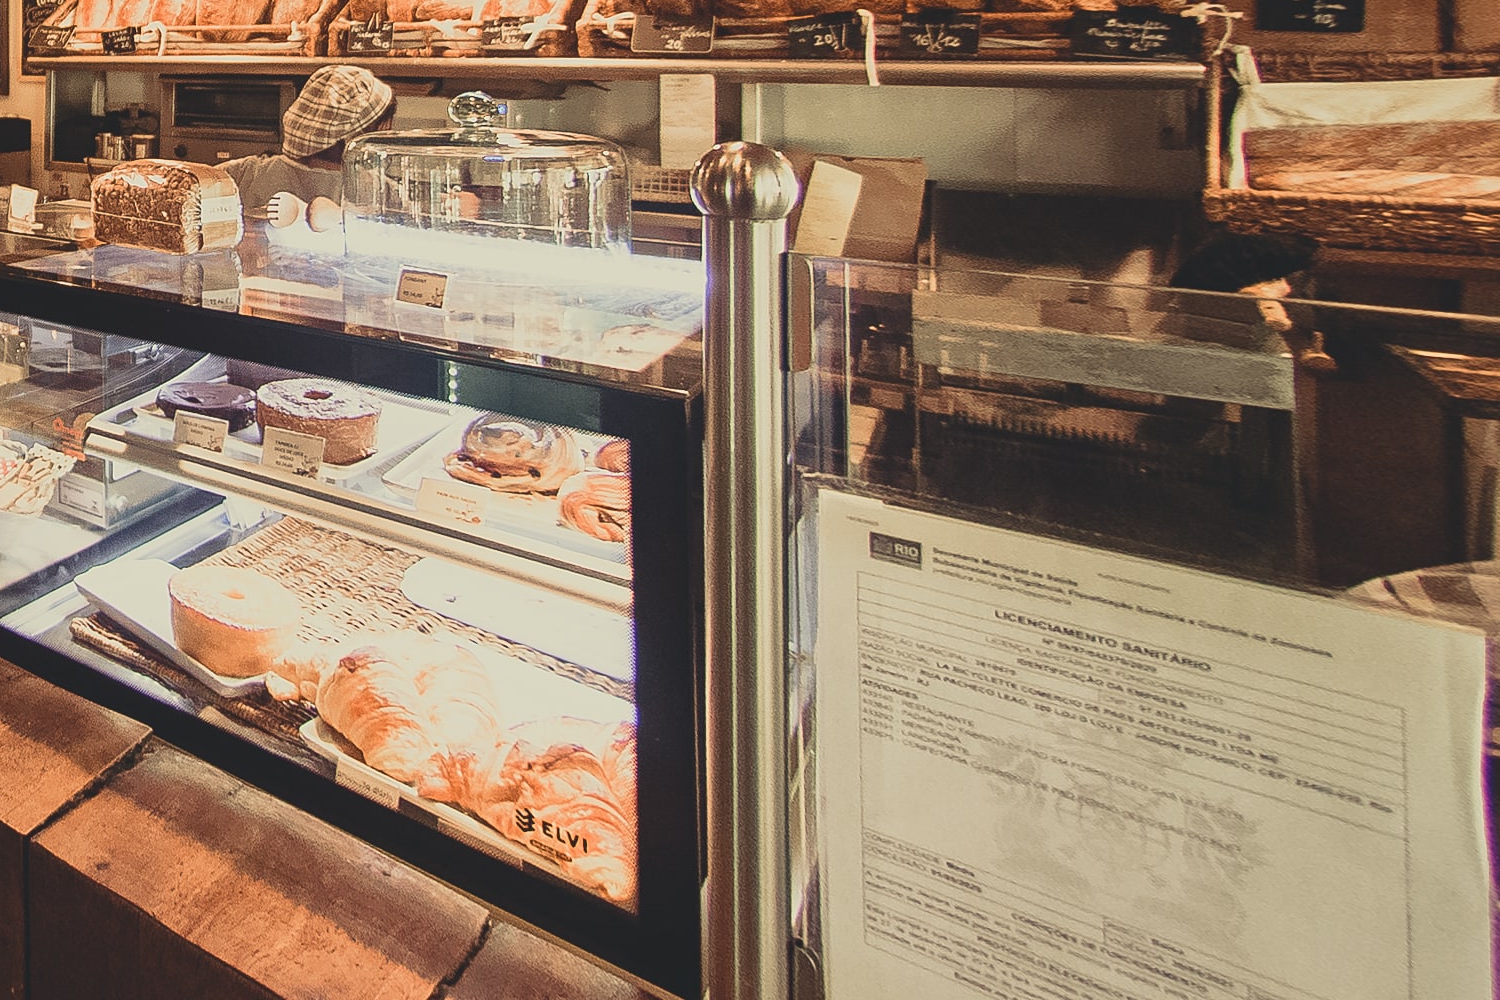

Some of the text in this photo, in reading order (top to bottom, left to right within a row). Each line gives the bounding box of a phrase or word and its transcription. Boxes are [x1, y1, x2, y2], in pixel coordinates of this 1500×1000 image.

[894, 542, 918, 558] RIO
[981, 558, 1027, 576] Municipal
[985, 635, 1030, 654] LICENÇA
[994, 609, 1117, 649] LICENCIAMENTO
[1122, 640, 1211, 673] SANITÁRIO
[936, 661, 950, 671] LA
[952, 665, 1017, 690] BICYCLETTE
[943, 675, 994, 696] PACHECO
[1016, 656, 1103, 687] IDENTIFICAÇÃO
[1127, 686, 1187, 710] EMPRESA
[861, 677, 918, 700] ATIVIDADES
[542, 820, 587, 853] ELVI
